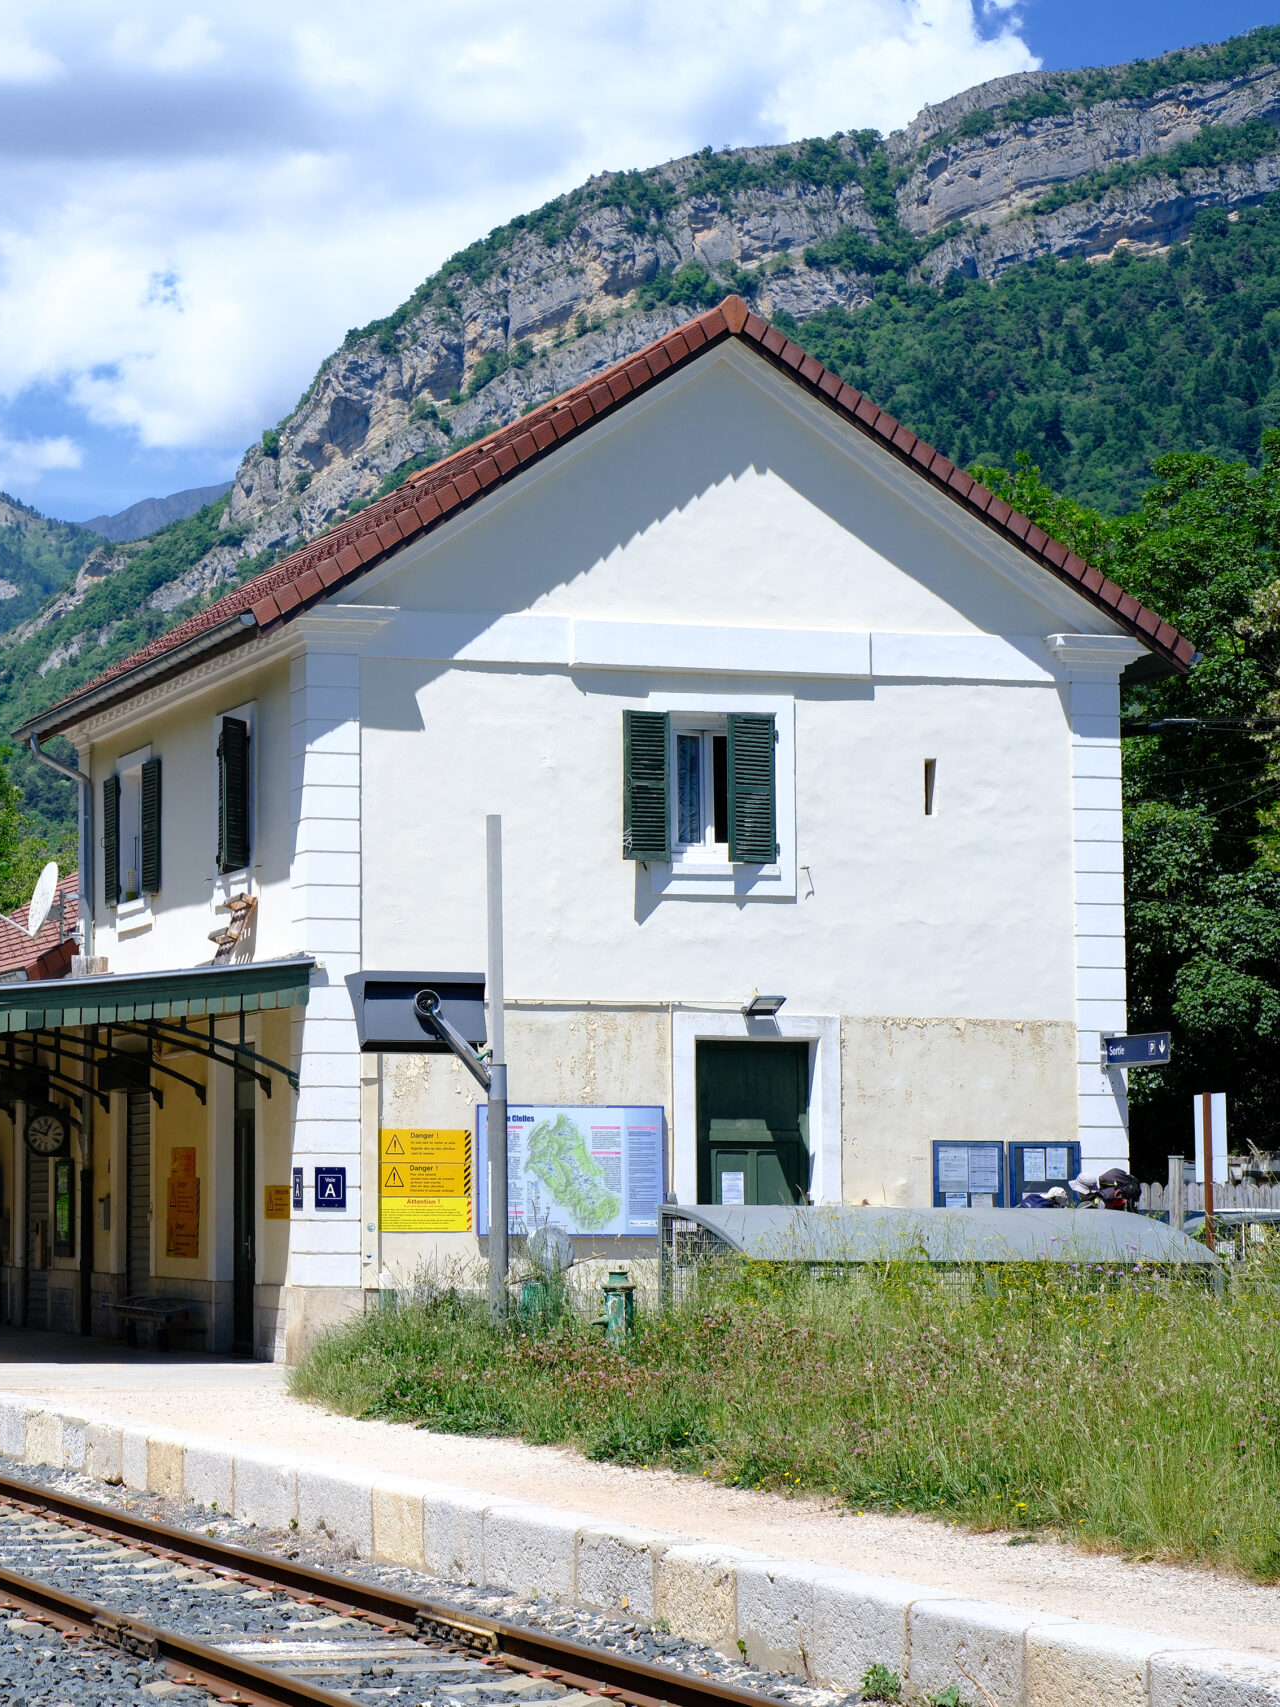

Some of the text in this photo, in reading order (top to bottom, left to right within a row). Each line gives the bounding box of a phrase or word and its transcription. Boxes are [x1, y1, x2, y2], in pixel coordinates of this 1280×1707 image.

[1109, 1045, 1125, 1056] Sortie
[512, 1114, 535, 1122] Clelles
[410, 1132, 434, 1140] Danger
[324, 1183, 336, 1198] A
